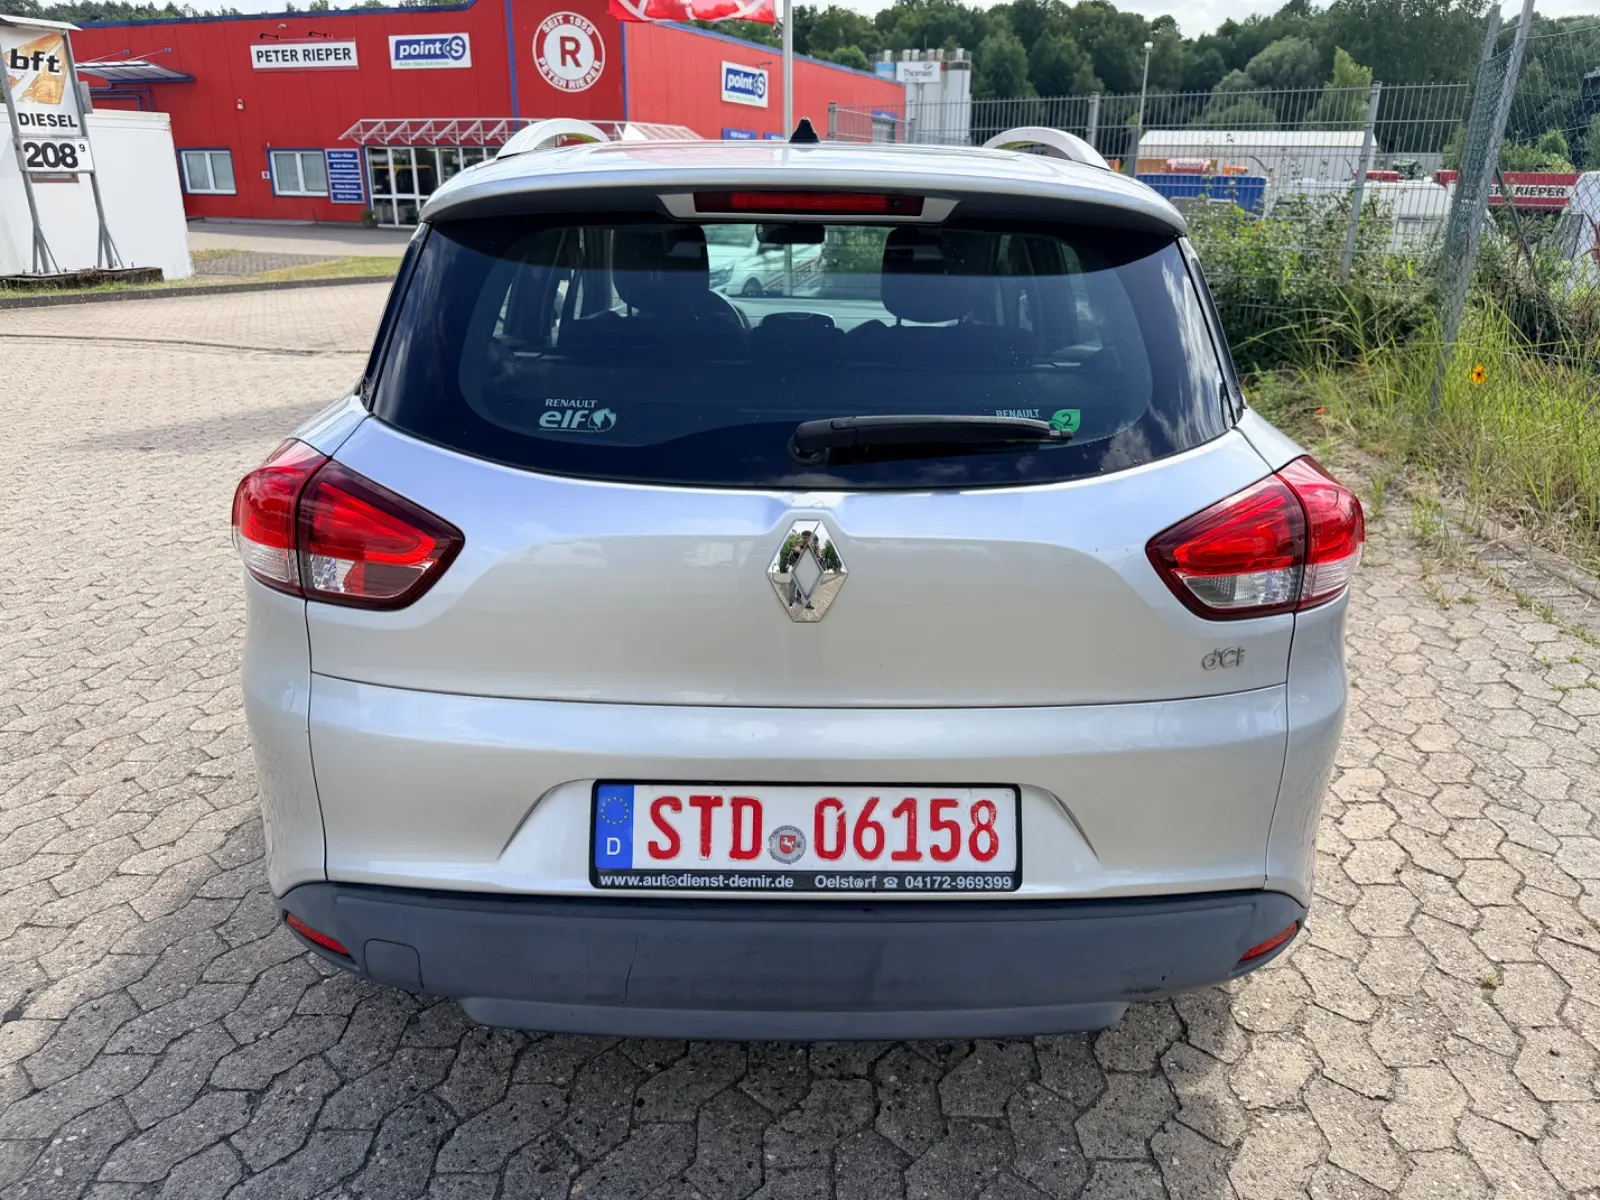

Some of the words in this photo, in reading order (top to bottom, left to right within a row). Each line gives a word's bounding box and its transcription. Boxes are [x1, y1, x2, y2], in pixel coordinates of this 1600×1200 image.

[541, 15, 564, 33] SEIT
[256, 48, 299, 63] PETER
[302, 47, 352, 62] RIEPER
[399, 40, 442, 58] point
[559, 36, 582, 68] R
[10, 48, 60, 73] bft
[538, 56, 567, 89] PETER
[567, 59, 602, 89] RIEPER
[726, 72, 753, 91] point
[18, 112, 78, 128] DIESEL
[23, 141, 79, 168] 208
[1514, 185, 1566, 197] RIEPER
[544, 398, 598, 408] RENAULT
[538, 409, 590, 428] elf
[995, 408, 1040, 418] RENAULT
[1061, 412, 1074, 427] 2
[647, 795, 763, 860] STD
[813, 796, 1000, 863] 06158
[607, 837, 621, 856] D
[599, 873, 794, 888] www.autodienst-demir.de
[813, 874, 877, 889] Oelstorf
[904, 876, 1012, 889] 04172-969399
